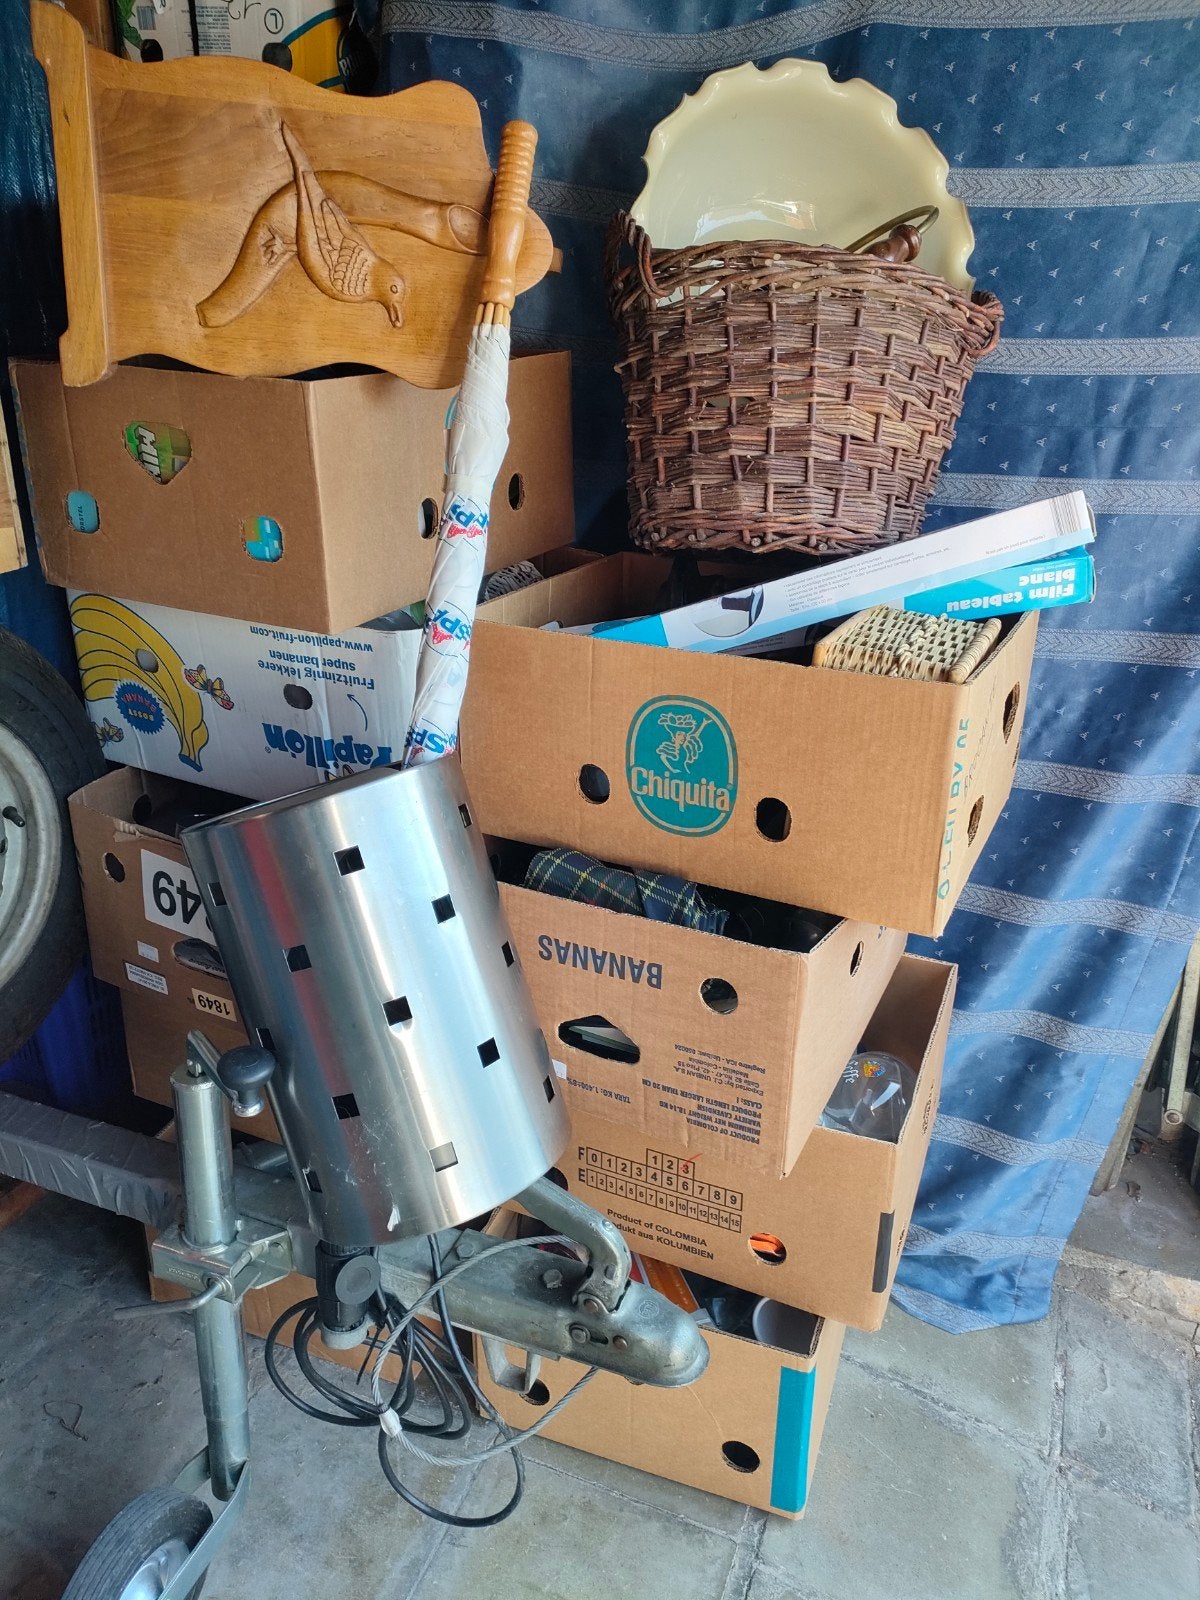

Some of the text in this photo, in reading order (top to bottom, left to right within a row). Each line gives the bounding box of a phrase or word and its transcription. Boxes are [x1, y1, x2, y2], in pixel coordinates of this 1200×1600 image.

[1018, 567, 1076, 587] blanc
[946, 583, 1075, 613] Film tableau
[250, 626, 373, 653] www.papillon-fruit.com
[268, 649, 356, 672] super bananen
[257, 660, 375, 690] Fruitzinnig lekkere
[631, 766, 729, 812] Chiquita
[153, 871, 202, 924] 49
[538, 934, 663, 991] BANANAS
[197, 994, 230, 1015] 1849
[731, 1105, 762, 1119] PRODUCE
[733, 1115, 761, 1128] VARIETY
[686, 1117, 760, 1145] PRODUCT OF COLOMBIA
[578, 1168, 585, 1182] E
[578, 1146, 585, 1161] F
[621, 1162, 628, 1172] 2
[636, 1167, 643, 1177] 3
[651, 1172, 658, 1182] 4
[666, 1176, 673, 1187] 5
[682, 1181, 689, 1191] 6
[698, 1186, 705, 1195] 7
[714, 1190, 721, 1200] 8
[730, 1195, 738, 1205] 9
[667, 1160, 674, 1170] 2
[607, 1208, 708, 1247] Product of COLOMBIA
[638, 1229, 654, 1241] aus
[656, 1235, 714, 1260] KOLUMBIEN
